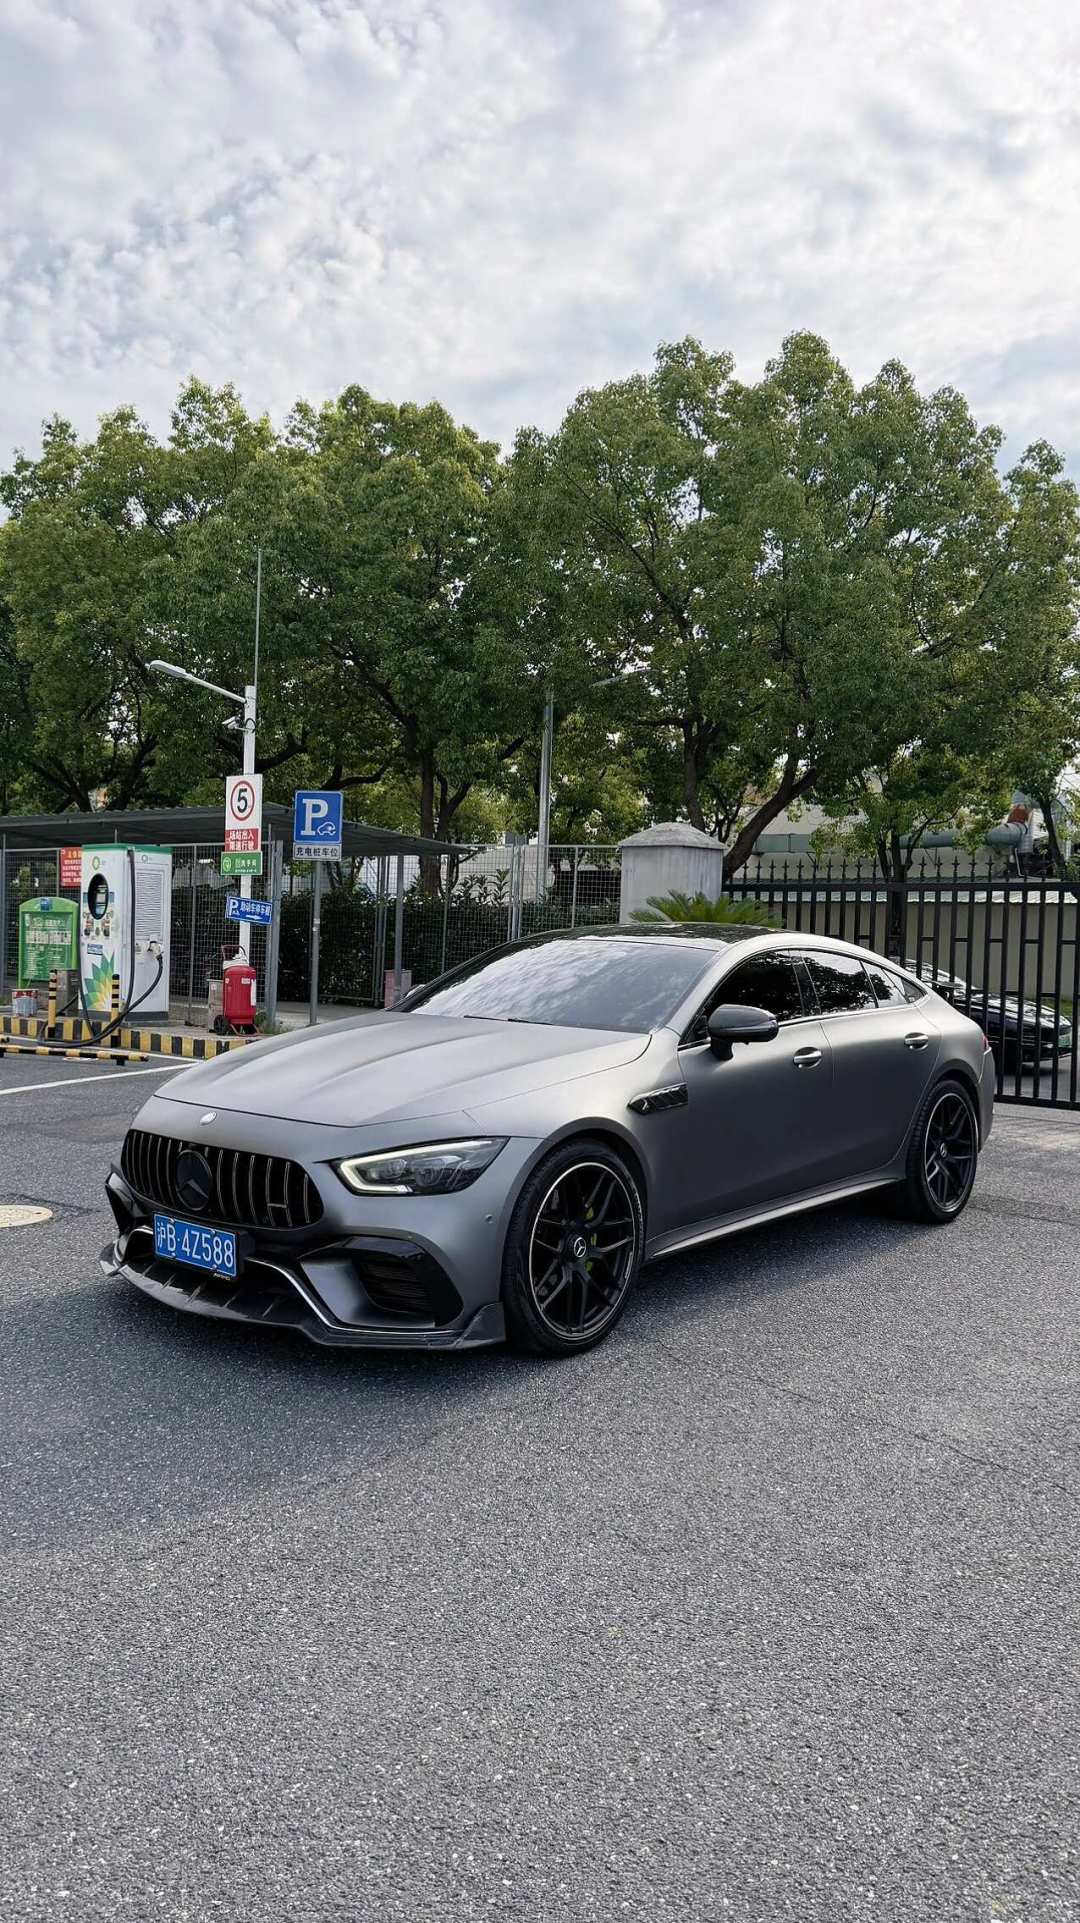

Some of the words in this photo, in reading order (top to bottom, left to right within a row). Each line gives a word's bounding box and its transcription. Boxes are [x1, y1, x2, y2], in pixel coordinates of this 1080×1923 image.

[237, 788, 248, 813] 5
[300, 798, 329, 836] P
[296, 846, 338, 857] 充电桩车位
[229, 899, 239, 916] P
